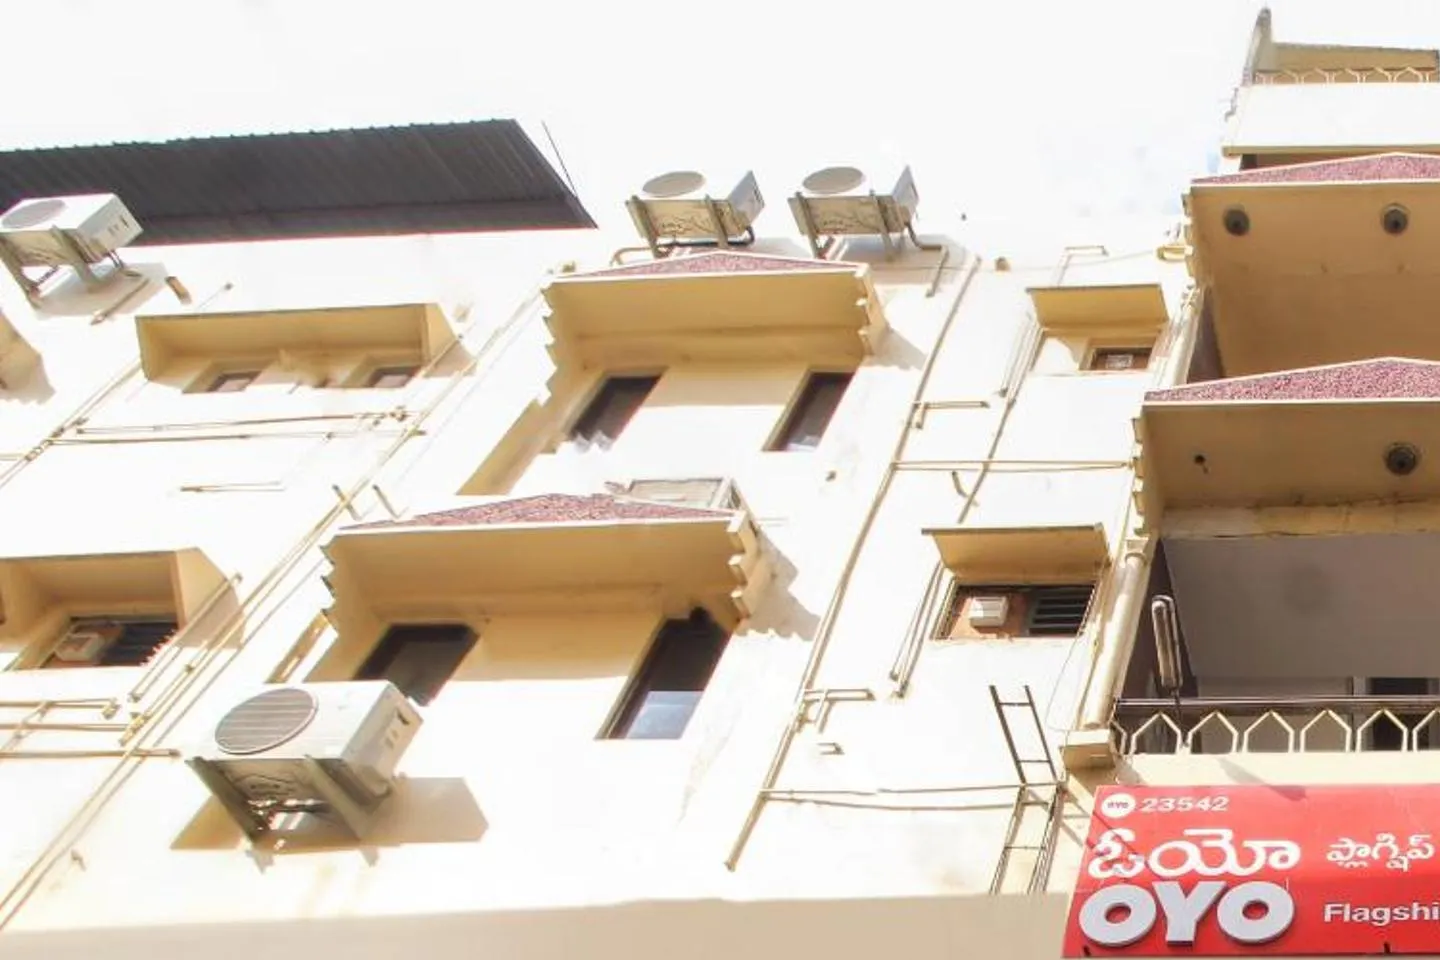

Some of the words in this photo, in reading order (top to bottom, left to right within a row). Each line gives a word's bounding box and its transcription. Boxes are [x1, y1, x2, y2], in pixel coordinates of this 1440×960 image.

[1141, 796, 1229, 812] 23542
[1088, 828, 1301, 878] ఓయో
[1078, 881, 1295, 946] OYO
